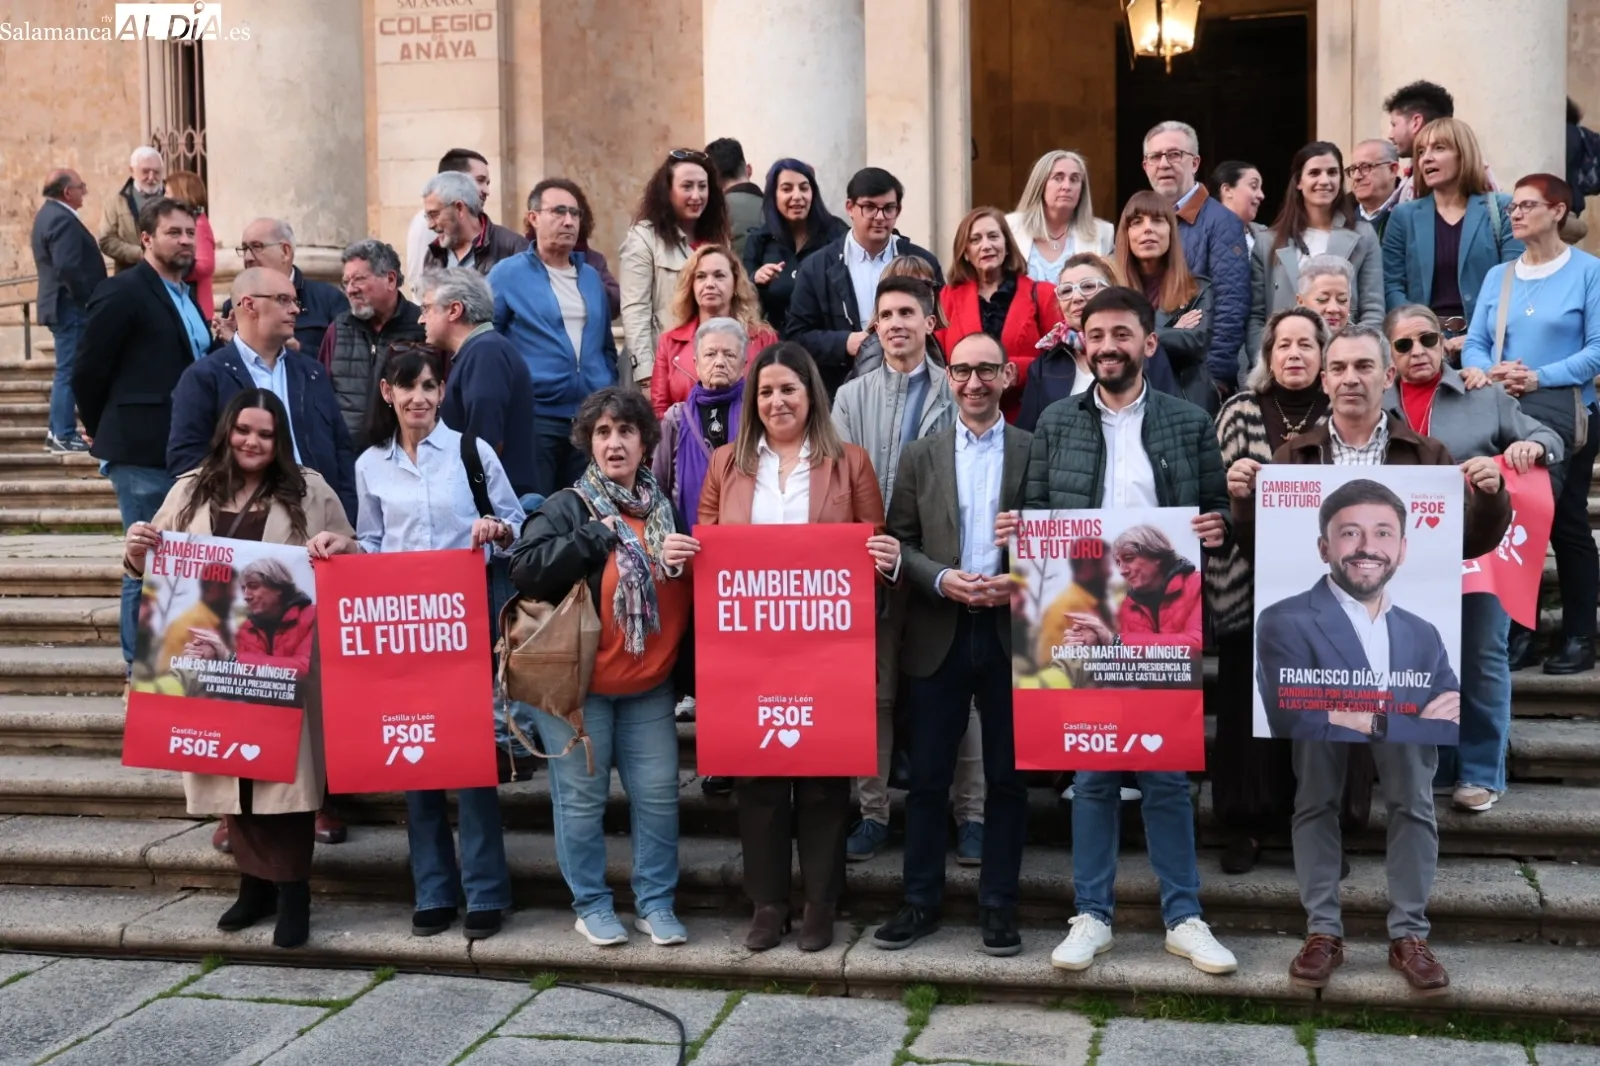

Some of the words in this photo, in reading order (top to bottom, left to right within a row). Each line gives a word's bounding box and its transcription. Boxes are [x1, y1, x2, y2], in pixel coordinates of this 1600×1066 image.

[380, 13, 493, 35] COLEGIO
[400, 40, 476, 60] ANAYA
[1262, 481, 1321, 493] CAMBIEMOS
[1262, 494, 1275, 508] EL
[1279, 494, 1320, 508] FUTURO
[1411, 501, 1445, 514] PSOE
[1017, 519, 1102, 538] CAMBIEMOS
[154, 538, 234, 563] CAMBIEMOS
[1017, 539, 1036, 559] EL
[1040, 539, 1103, 559] FUTURO
[152, 555, 169, 576] EL
[174, 559, 233, 584] FUTURO
[718, 569, 851, 597] CAMBIEMOS
[339, 592, 466, 624] CAMBIEMOS
[718, 600, 748, 631] EL
[755, 599, 851, 631] FUTURO
[340, 626, 370, 656] EL
[375, 621, 467, 654] FUTURO
[1051, 645, 1089, 659] CARLOS
[1091, 643, 1142, 659] MARTÍNEZ
[1145, 643, 1191, 659] MÍNGUEZ
[170, 656, 206, 671] CARLOS
[208, 658, 254, 677] MARTÍNEZ
[256, 662, 297, 681] MÍNGUEZ
[1083, 662, 1120, 671] CANDIDATO
[1121, 663, 1126, 671] A
[1127, 663, 1136, 671] LA
[1137, 663, 1180, 671] PRESIDENCIA
[1182, 663, 1191, 671] DE
[1094, 672, 1102, 681] LA
[1104, 672, 1123, 681] JUNTA
[1125, 672, 1134, 681] DE
[1135, 672, 1167, 681] CASTILLA
[1167, 673, 1172, 681] Y
[1174, 671, 1191, 681] LEÓN
[198, 674, 232, 685] CANDIDATO
[233, 678, 238, 686] A
[239, 678, 247, 686] LA
[247, 679, 286, 691] PRESIDENCIA
[287, 683, 296, 692] DE
[1279, 668, 1349, 686] FRANCISCO
[1353, 667, 1384, 687] DÍAZ
[1388, 669, 1432, 688] MUÑOZ
[206, 684, 214, 692] LA
[215, 684, 234, 694] JUNTA
[235, 686, 244, 695] DE
[244, 687, 273, 698] CASTILLA
[273, 690, 278, 698] Y
[758, 695, 787, 703] Castilla
[788, 696, 793, 704] y
[794, 694, 813, 703] León
[1278, 687, 1323, 698] CANDIDATO
[1325, 689, 1341, 698] POR
[1343, 689, 1393, 700] SALAMANCA
[1279, 699, 1285, 708] A
[1286, 699, 1301, 709] LAS
[1303, 700, 1333, 710] CORTES
[1336, 701, 1347, 712] DE
[1349, 701, 1386, 712] CASTILLA
[1388, 702, 1394, 712] Y
[382, 713, 410, 722] Castilla
[417, 712, 435, 720] León
[758, 705, 813, 726] PSOE
[171, 726, 197, 735] Castilla
[204, 730, 221, 738] León
[383, 723, 436, 744] PSOE
[1063, 722, 1091, 730] Castilla
[1099, 722, 1117, 730] León
[169, 736, 220, 758] PSOE
[1064, 733, 1118, 752] PSOE
